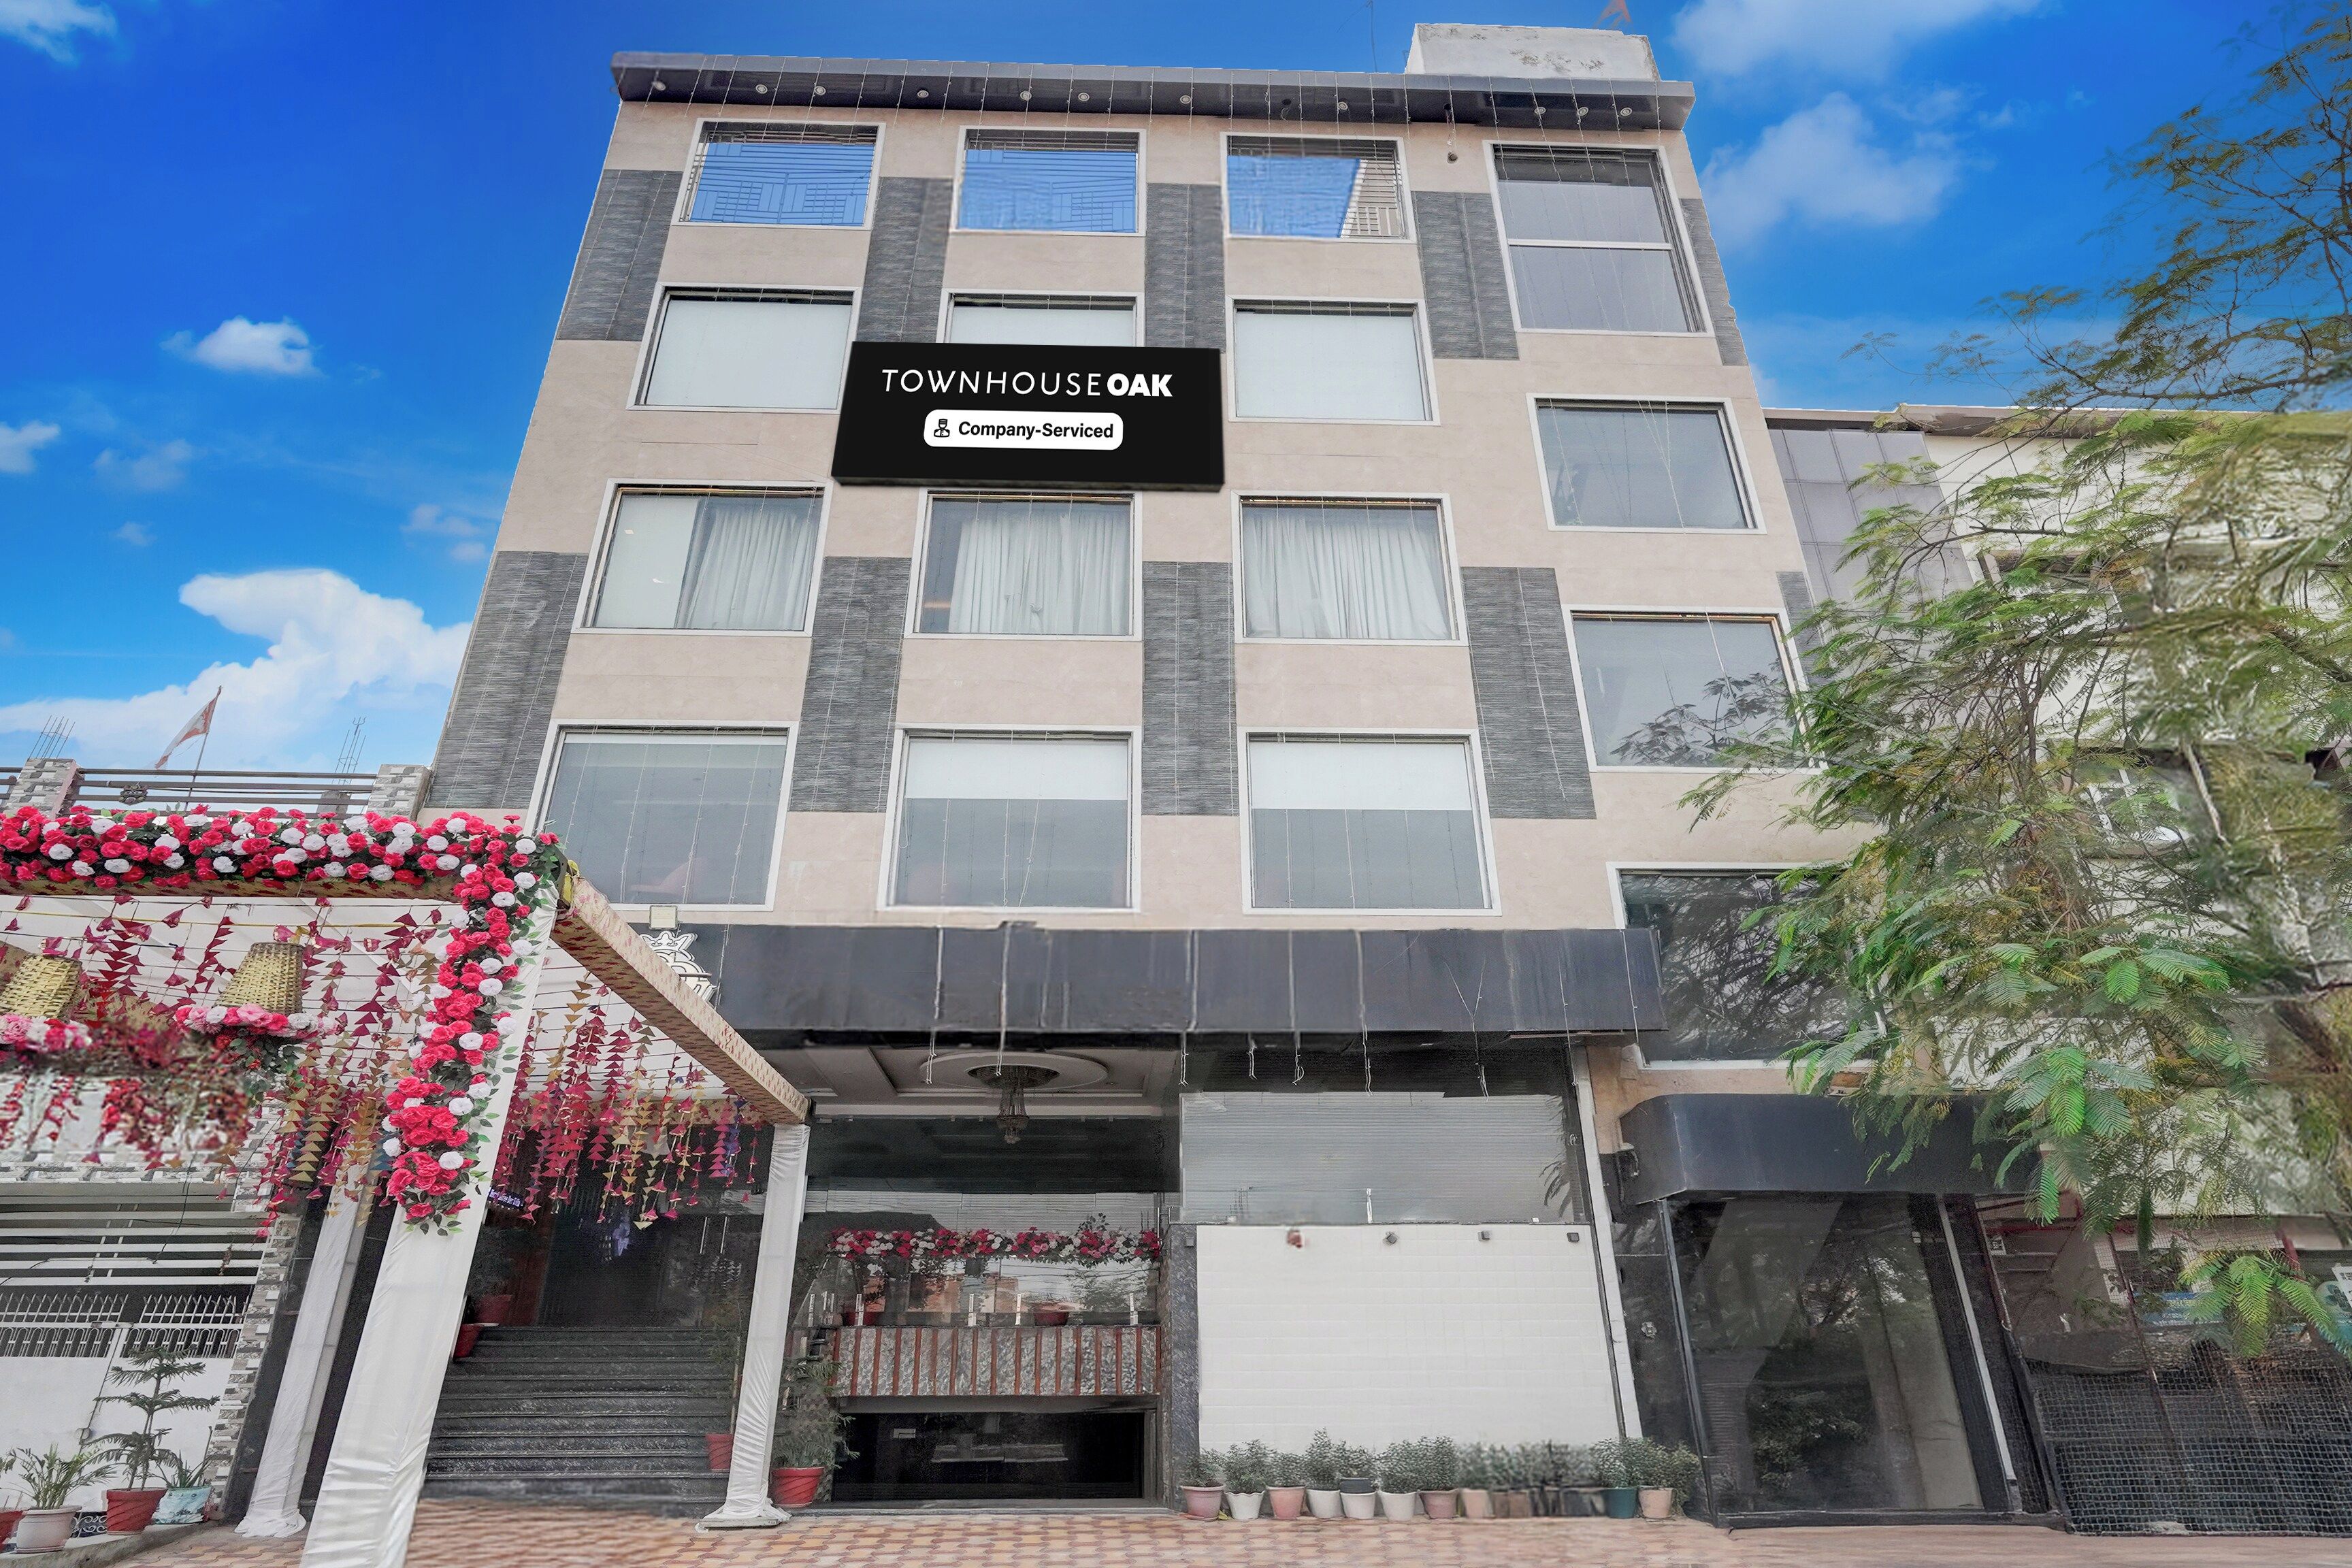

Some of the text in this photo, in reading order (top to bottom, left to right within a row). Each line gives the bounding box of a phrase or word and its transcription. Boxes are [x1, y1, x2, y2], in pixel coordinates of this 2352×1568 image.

[881, 369, 1173, 397] TOWNHOUSE OAK
[958, 421, 1113, 440] Company-Serviced
